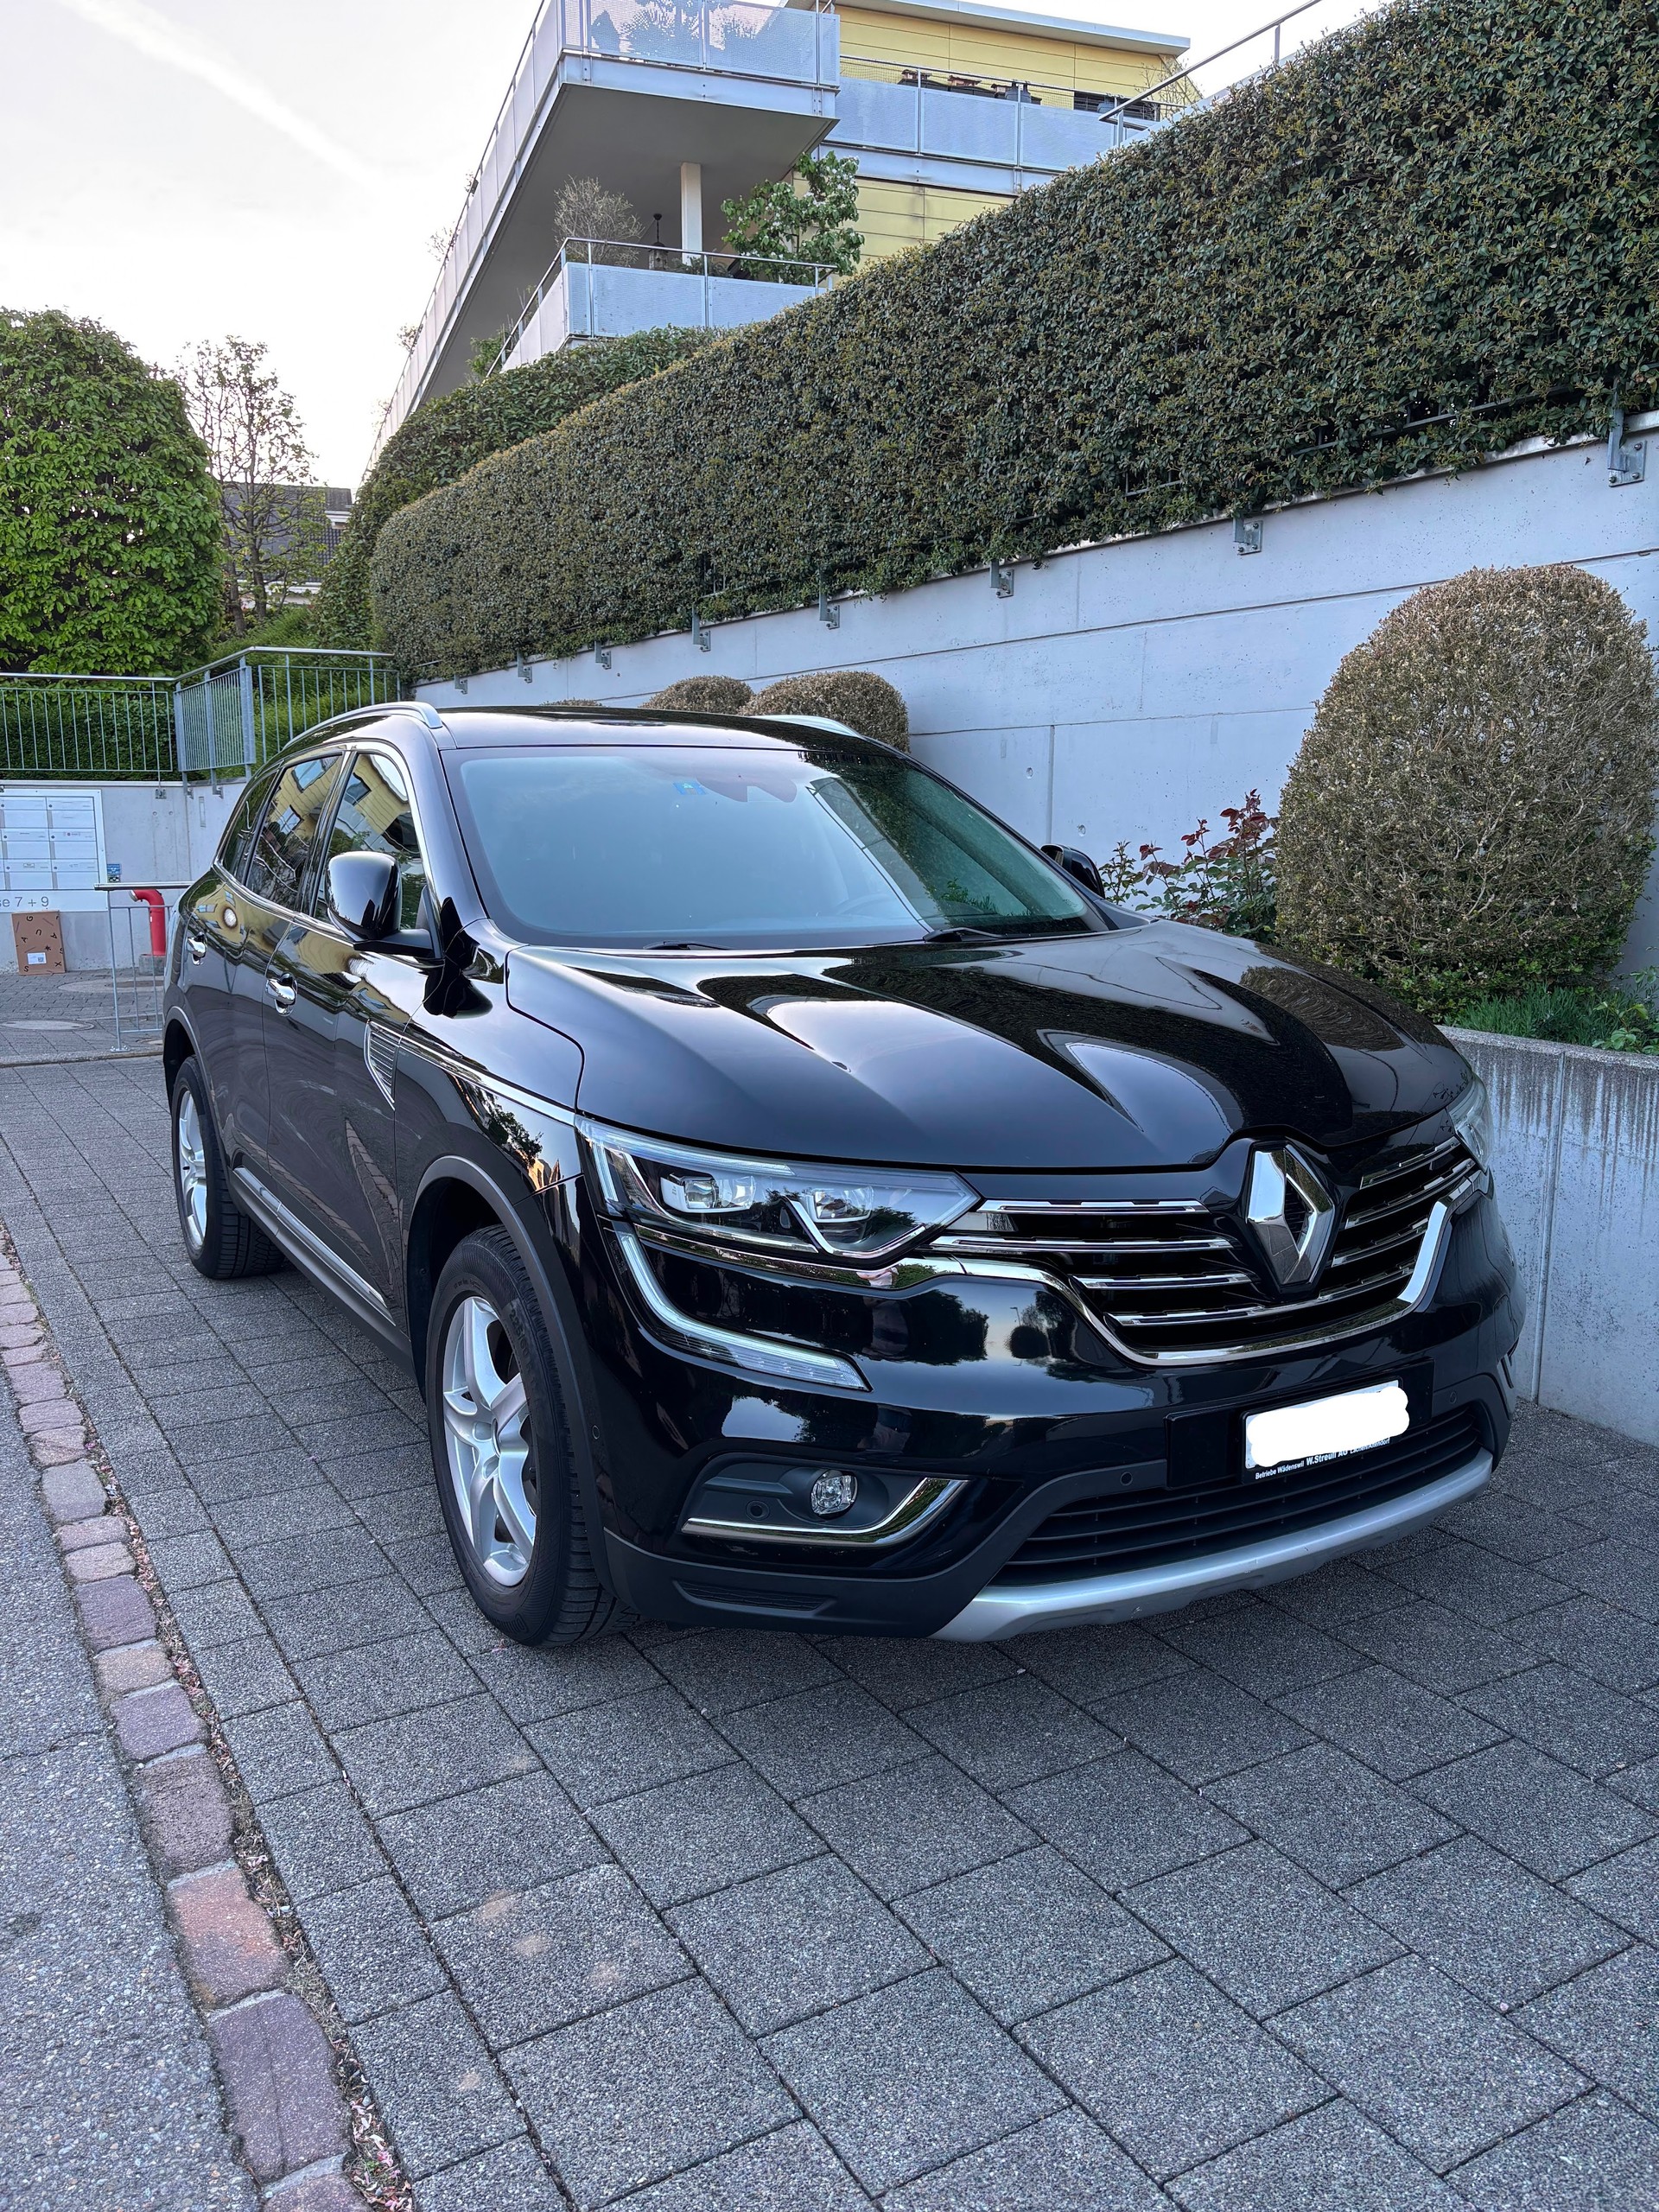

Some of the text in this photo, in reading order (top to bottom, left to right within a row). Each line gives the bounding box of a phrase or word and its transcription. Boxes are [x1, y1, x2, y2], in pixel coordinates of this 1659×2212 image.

[0, 896, 49, 907] e 7 + 9
[1255, 1469, 1276, 1479] Betriebe
[1277, 1460, 1305, 1473] Wädenswil
